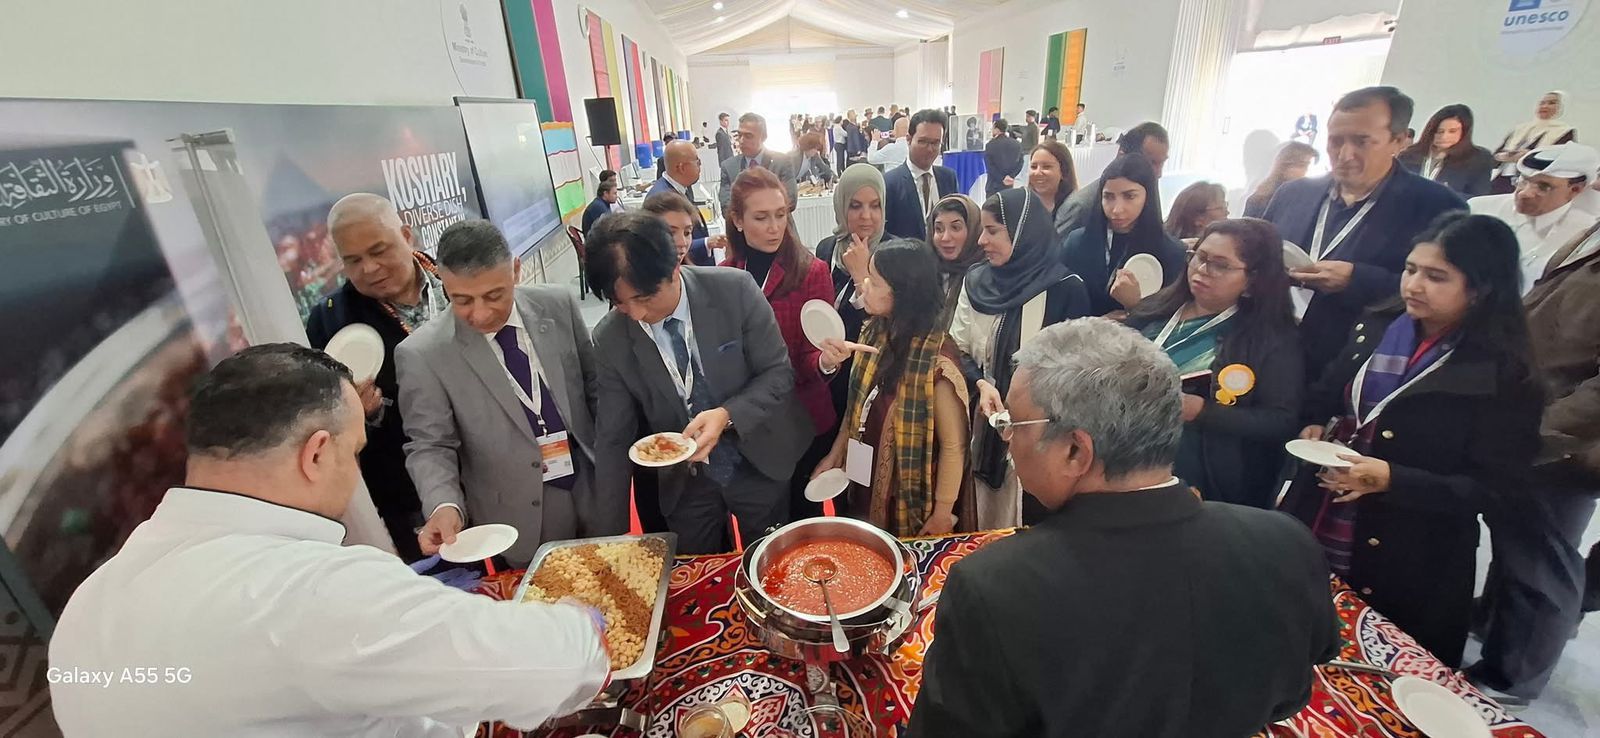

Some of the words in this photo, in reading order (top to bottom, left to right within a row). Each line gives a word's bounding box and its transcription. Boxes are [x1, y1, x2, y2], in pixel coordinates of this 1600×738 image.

[1504, 10, 1569, 27] unesco
[381, 152, 467, 212] KOSHARY,
[13, 213, 29, 225] OF
[32, 207, 77, 222] CULTURE
[78, 204, 92, 215] OF
[404, 202, 444, 228] DIVERSE
